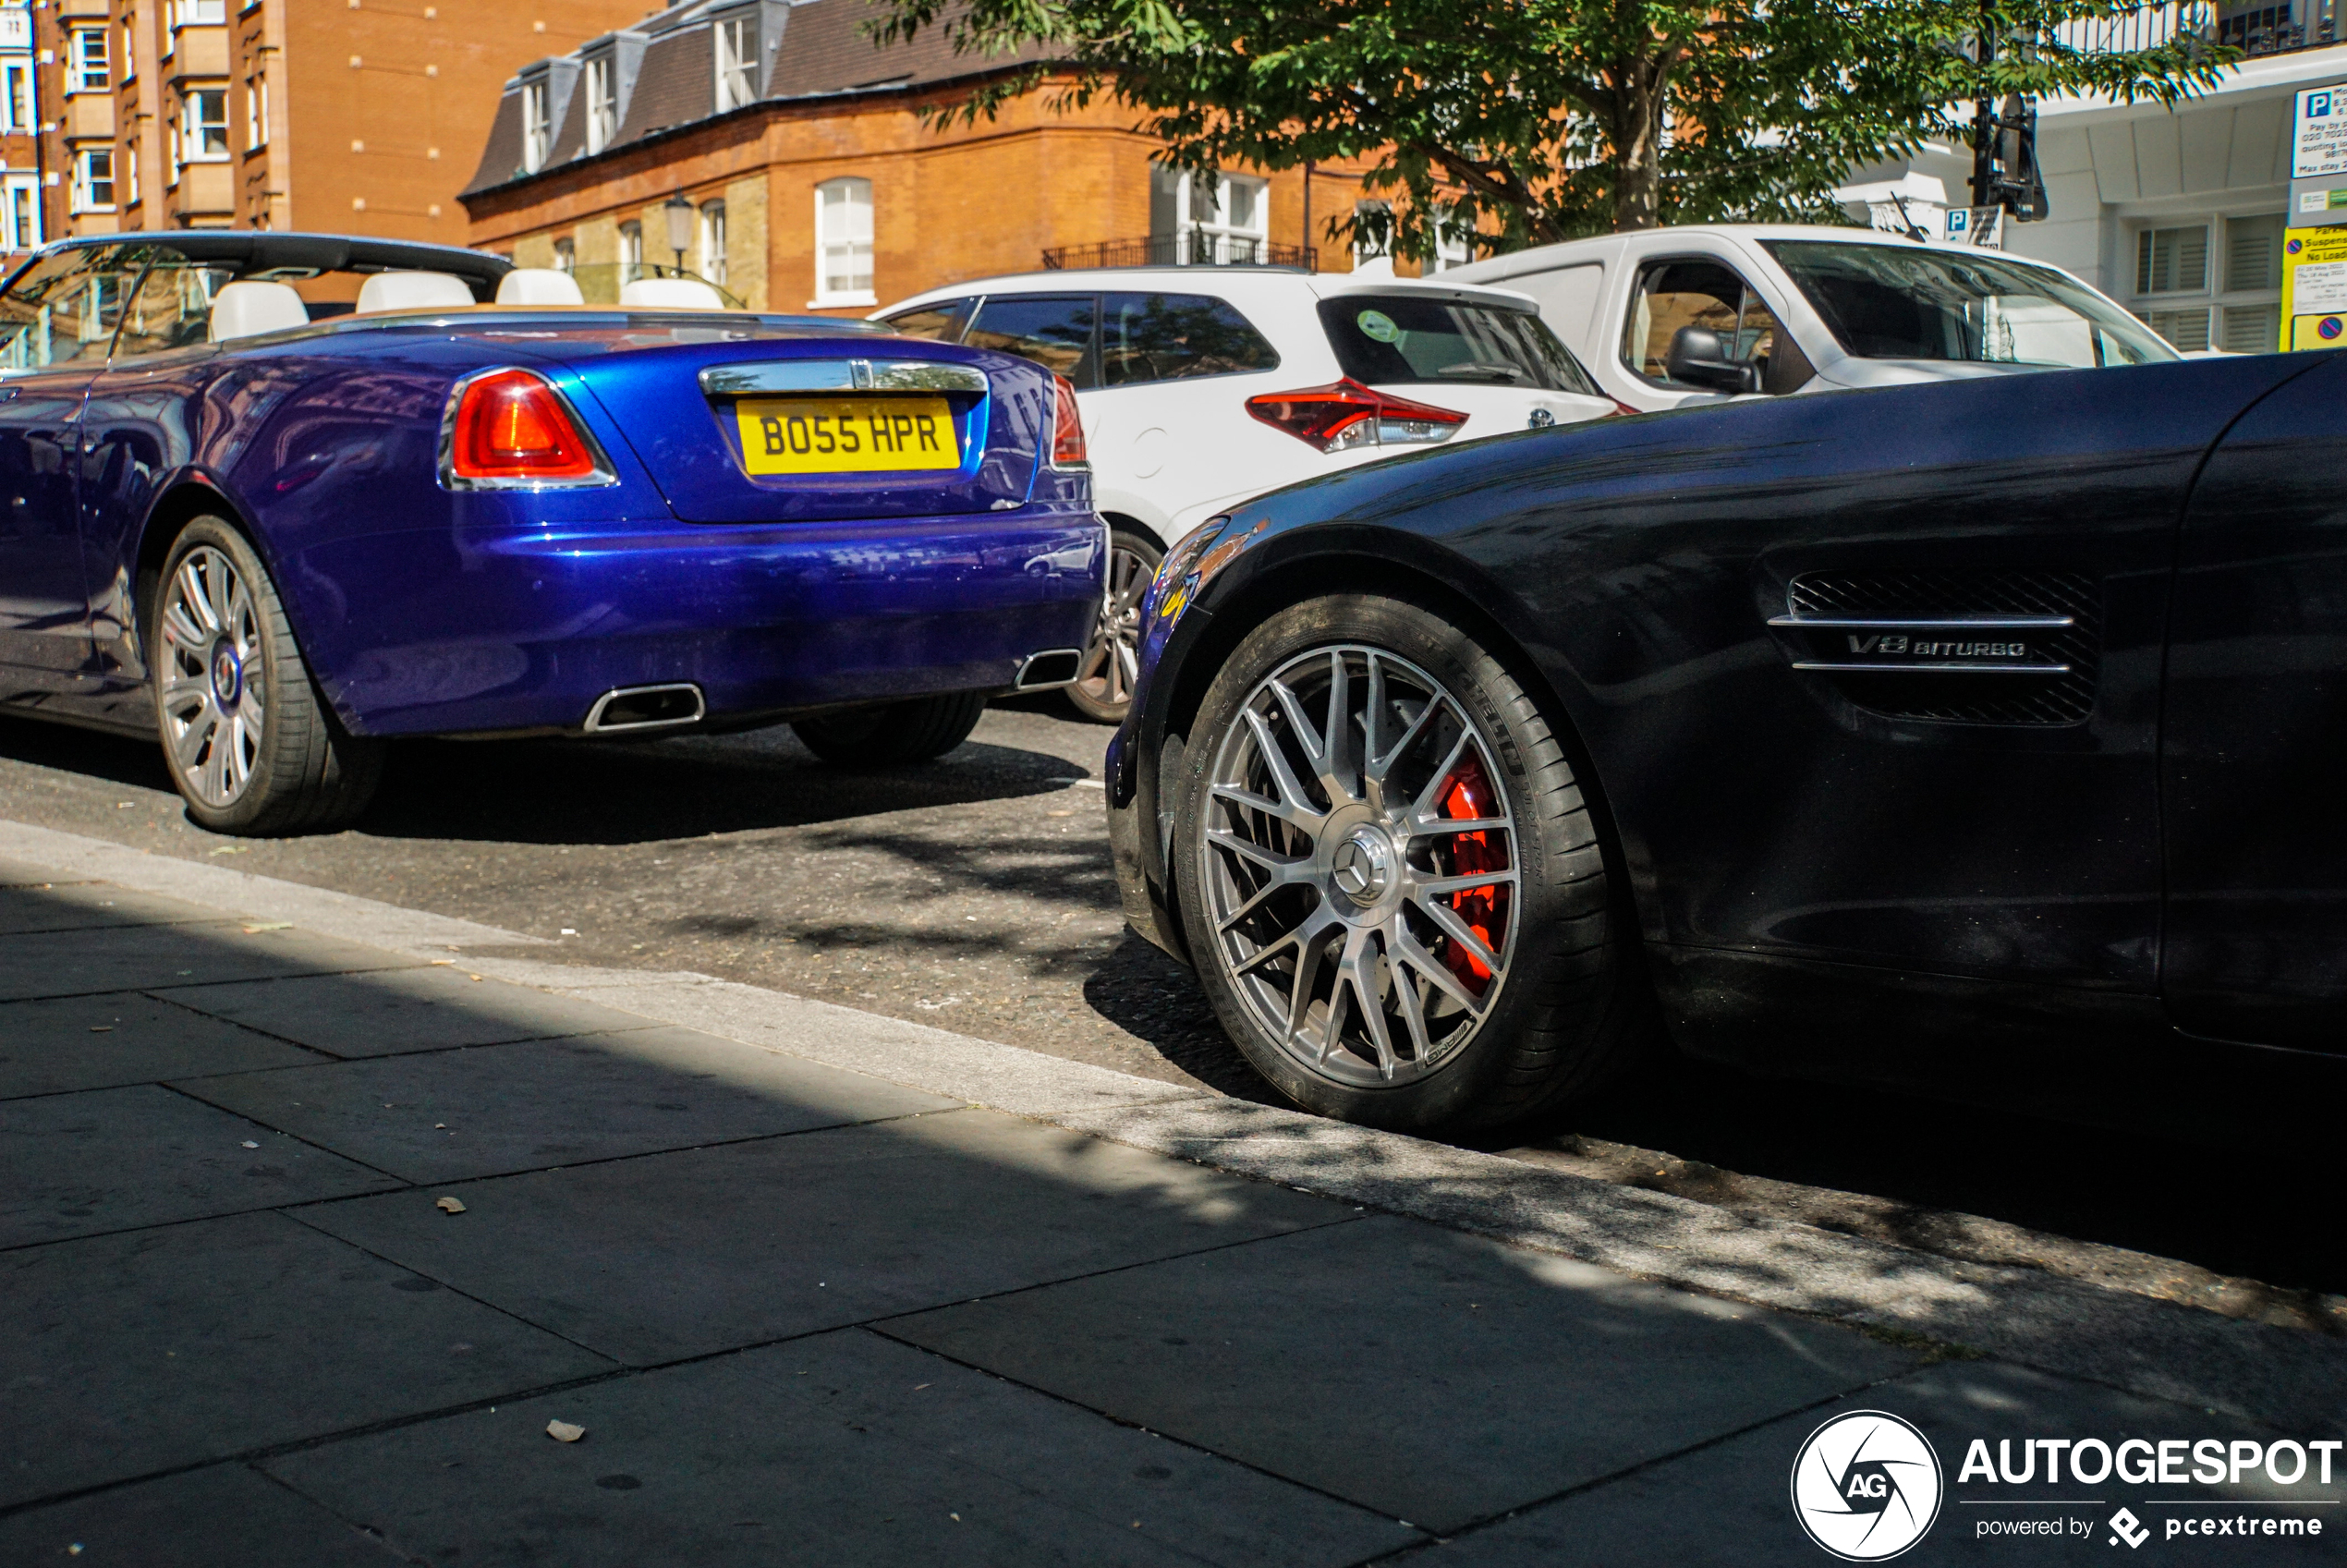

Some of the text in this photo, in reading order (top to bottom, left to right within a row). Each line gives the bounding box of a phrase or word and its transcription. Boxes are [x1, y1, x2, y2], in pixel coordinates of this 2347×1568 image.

[2309, 124, 2326, 132] Pay
[2329, 122, 2340, 130] by
[2302, 133, 2321, 141] 020
[2302, 141, 2337, 153] quoting
[2320, 162, 2340, 171] stay
[2307, 252, 2320, 262] No
[760, 414, 941, 456] BO55 HPR
[1847, 634, 2025, 657] V8 BITURBO
[1428, 1034, 1455, 1062] AMG
